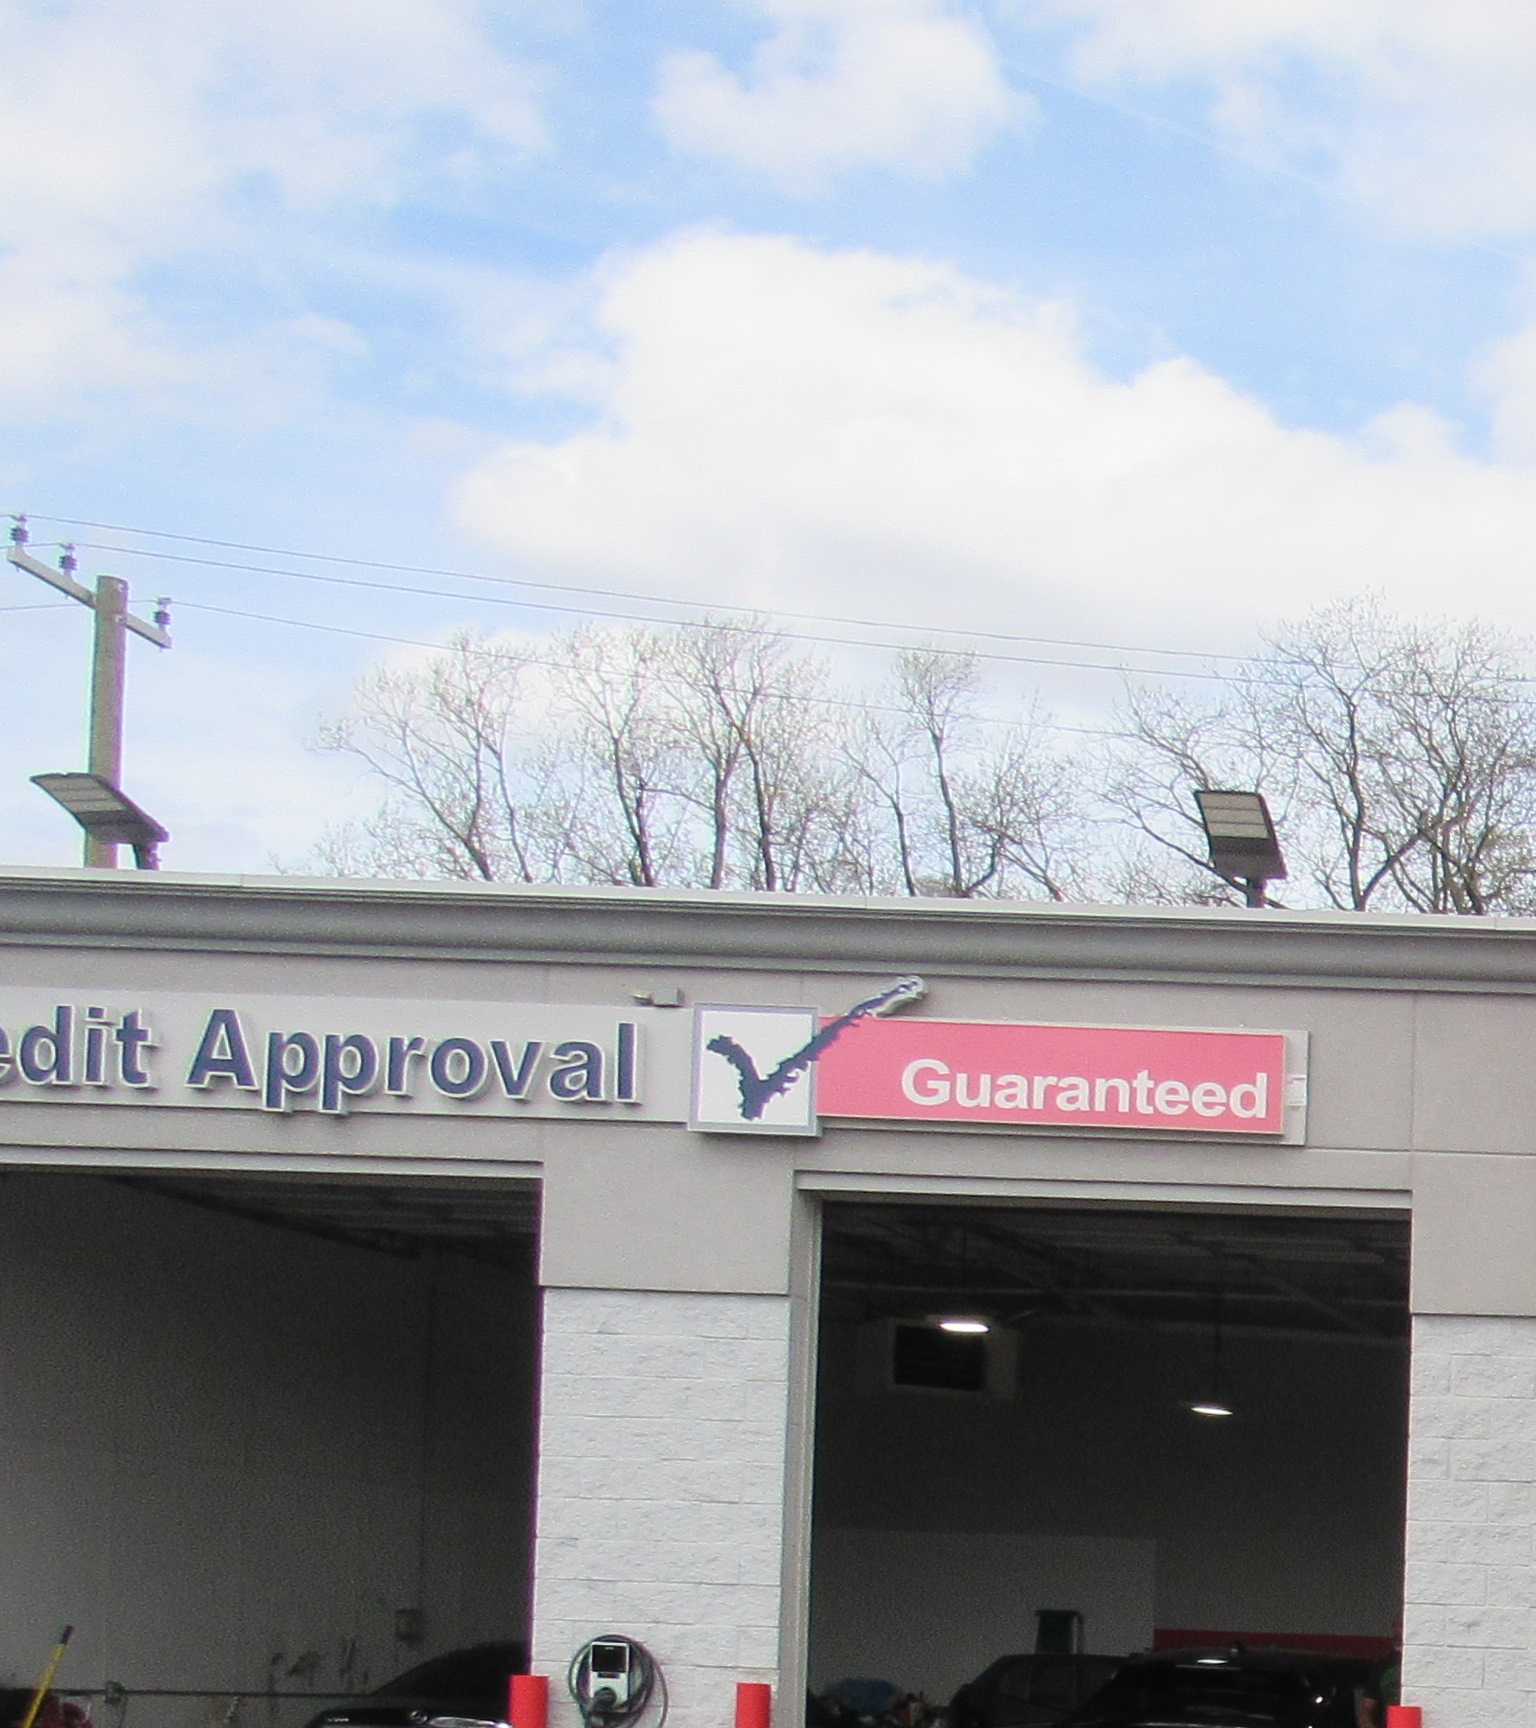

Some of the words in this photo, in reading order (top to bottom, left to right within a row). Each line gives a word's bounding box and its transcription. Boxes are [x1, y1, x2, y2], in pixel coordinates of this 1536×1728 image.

[0, 1004, 153, 1090] dit
[185, 1007, 639, 1115] Approval
[900, 1058, 1269, 1120] Guaranteed
